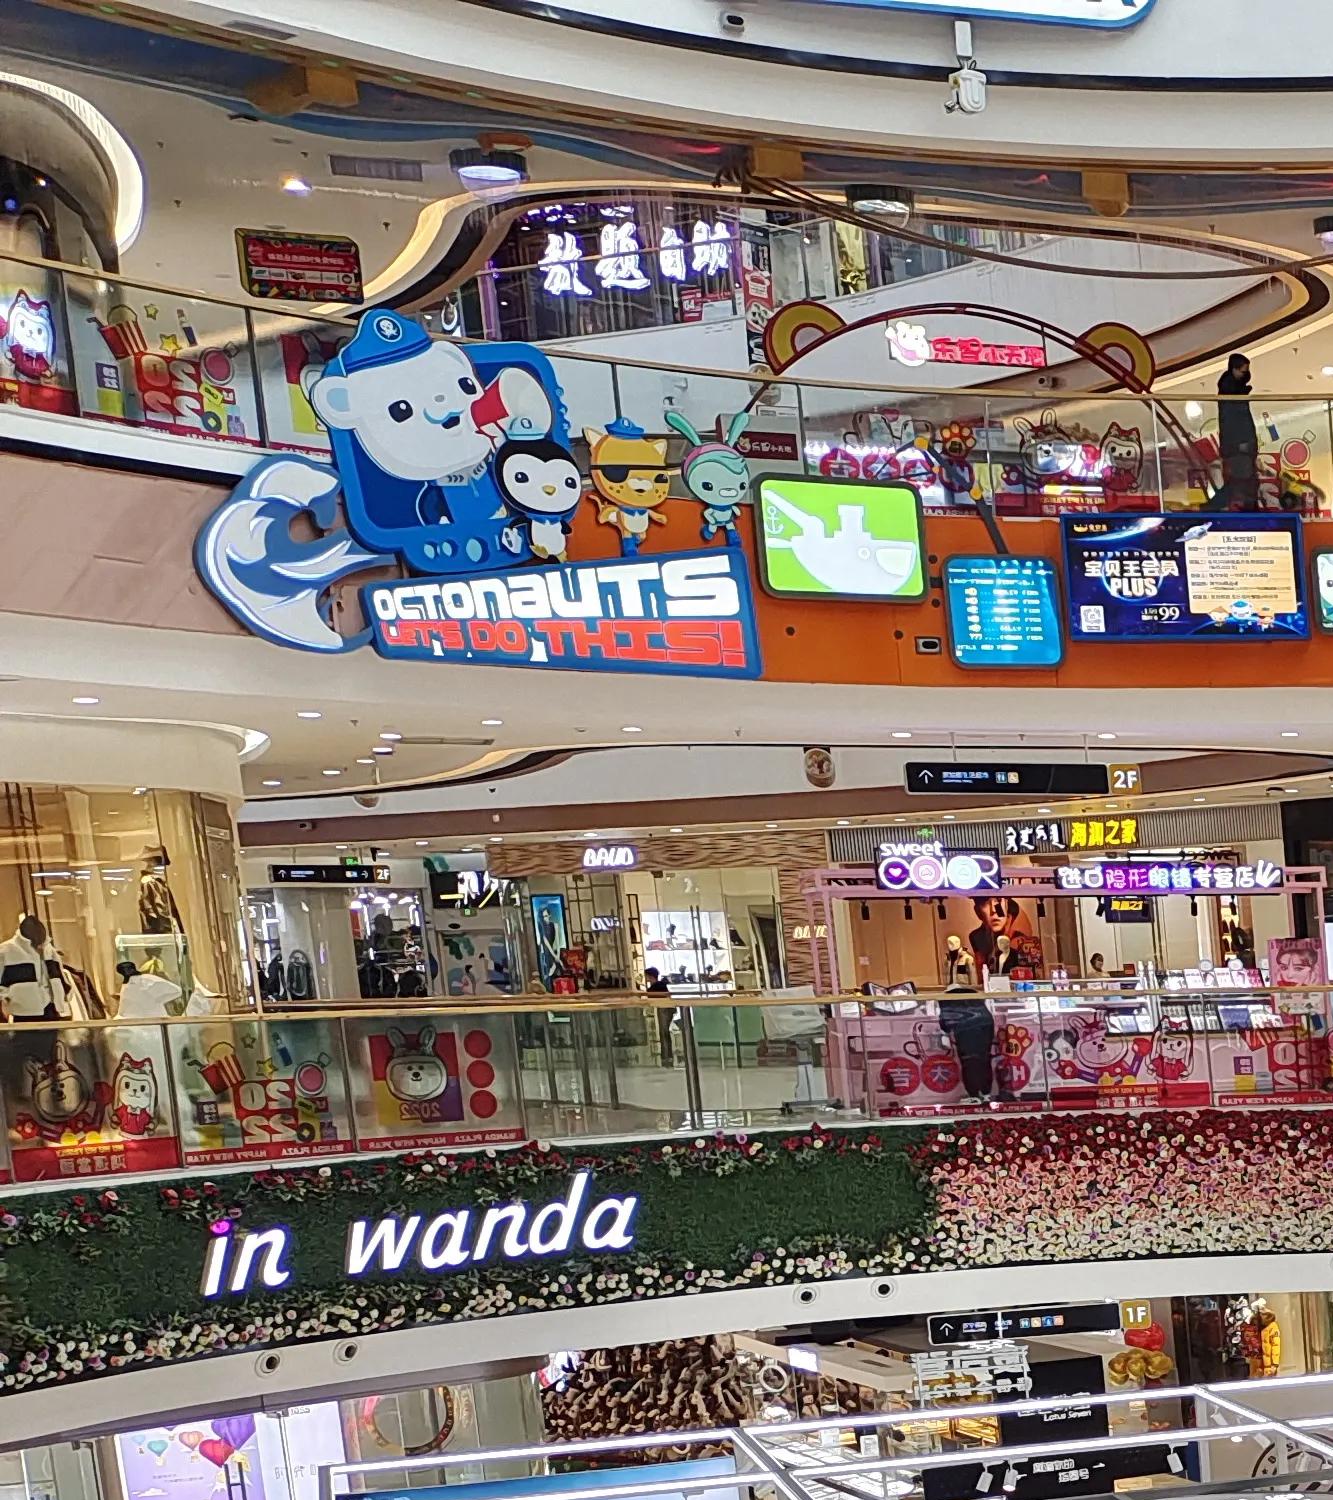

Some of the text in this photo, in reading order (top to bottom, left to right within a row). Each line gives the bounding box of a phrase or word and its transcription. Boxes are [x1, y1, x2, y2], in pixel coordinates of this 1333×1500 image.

[1084, 560, 1179, 577] 宝贝王会员
[374, 555, 740, 621] OCTONAUTS
[1111, 578, 1158, 596] PLUS
[1159, 606, 1180, 621] 99
[467, 621, 528, 653] DO
[534, 620, 747, 668] THIS!
[1113, 770, 1137, 789] 2F
[879, 841, 944, 857] sweet
[1058, 865, 1255, 890] 进口隐形眼镜专营店
[203, 1169, 640, 1297] in wanda
[1126, 1307, 1148, 1323] 1F
